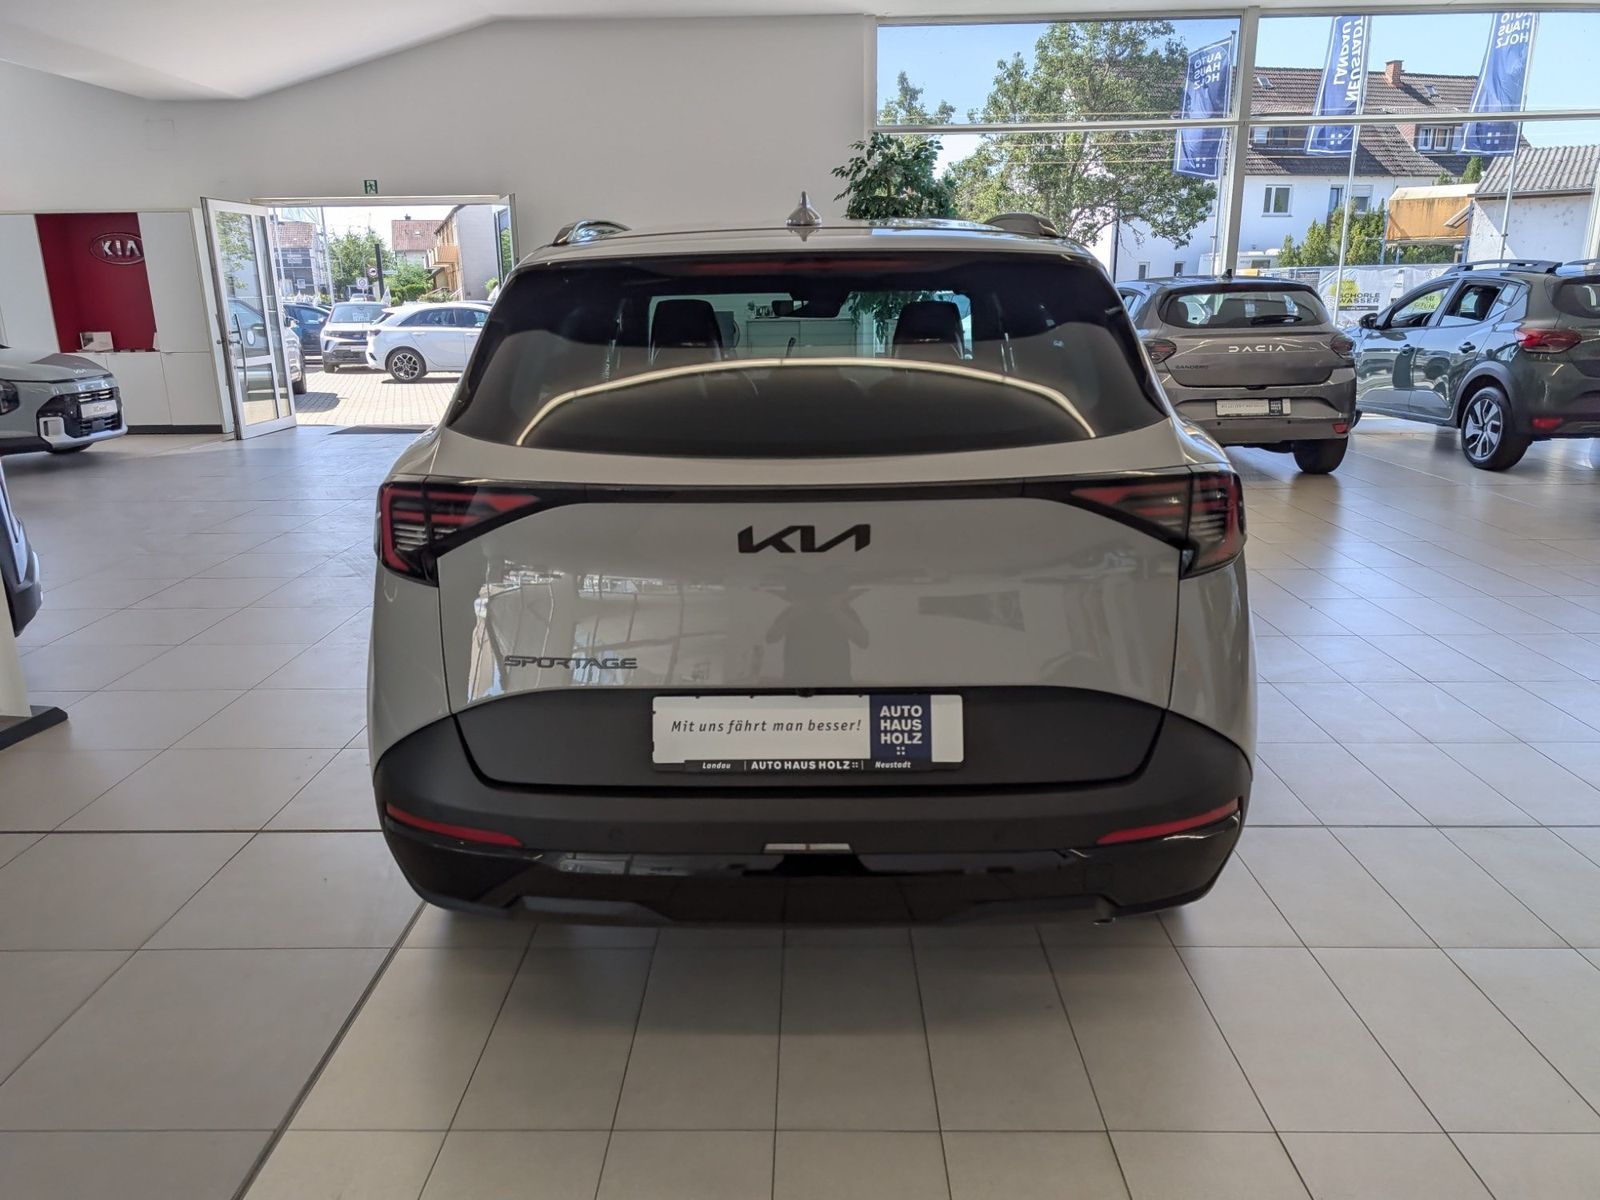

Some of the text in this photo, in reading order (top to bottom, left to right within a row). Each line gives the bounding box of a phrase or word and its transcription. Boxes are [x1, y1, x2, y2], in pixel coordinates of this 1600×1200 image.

[101, 240, 141, 257] KIA
[1228, 345, 1286, 353] DACIA
[738, 524, 871, 553] KIA
[503, 655, 639, 670] SPORTAGE
[880, 705, 923, 718] AUTO
[671, 719, 862, 735] Mit uns fährt man besser!
[880, 719, 923, 731] HAUS
[880, 732, 923, 745] HOLZ
[702, 761, 911, 770] Landau AUTO HAUS HOLZ Neustadt
